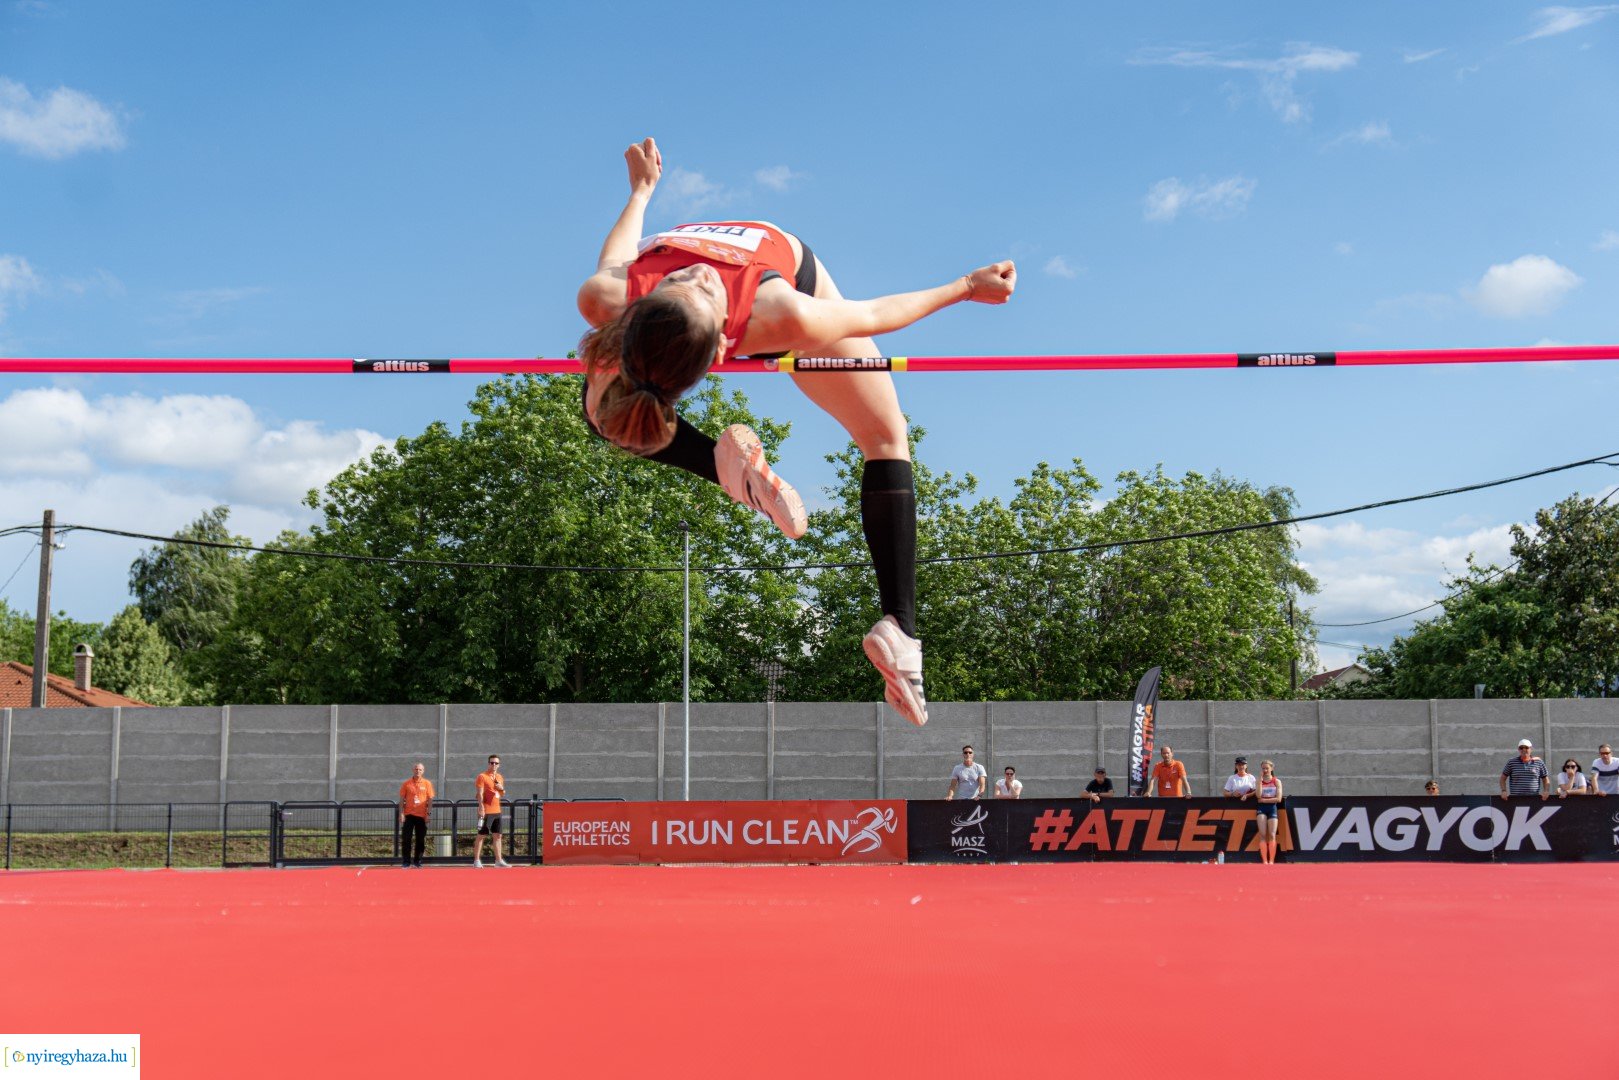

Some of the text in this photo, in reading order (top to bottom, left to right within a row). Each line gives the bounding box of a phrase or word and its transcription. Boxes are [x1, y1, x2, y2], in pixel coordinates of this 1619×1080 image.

[372, 360, 430, 372] altius
[797, 357, 887, 368] altius.hu
[1257, 354, 1316, 366] altius
[1132, 703, 1145, 782] #MAGYAR
[553, 821, 630, 833] EUROPEAN
[651, 820, 658, 845] I
[666, 820, 733, 845] RUN
[553, 834, 630, 846] ATHLETICS
[951, 836, 986, 847] MASZ
